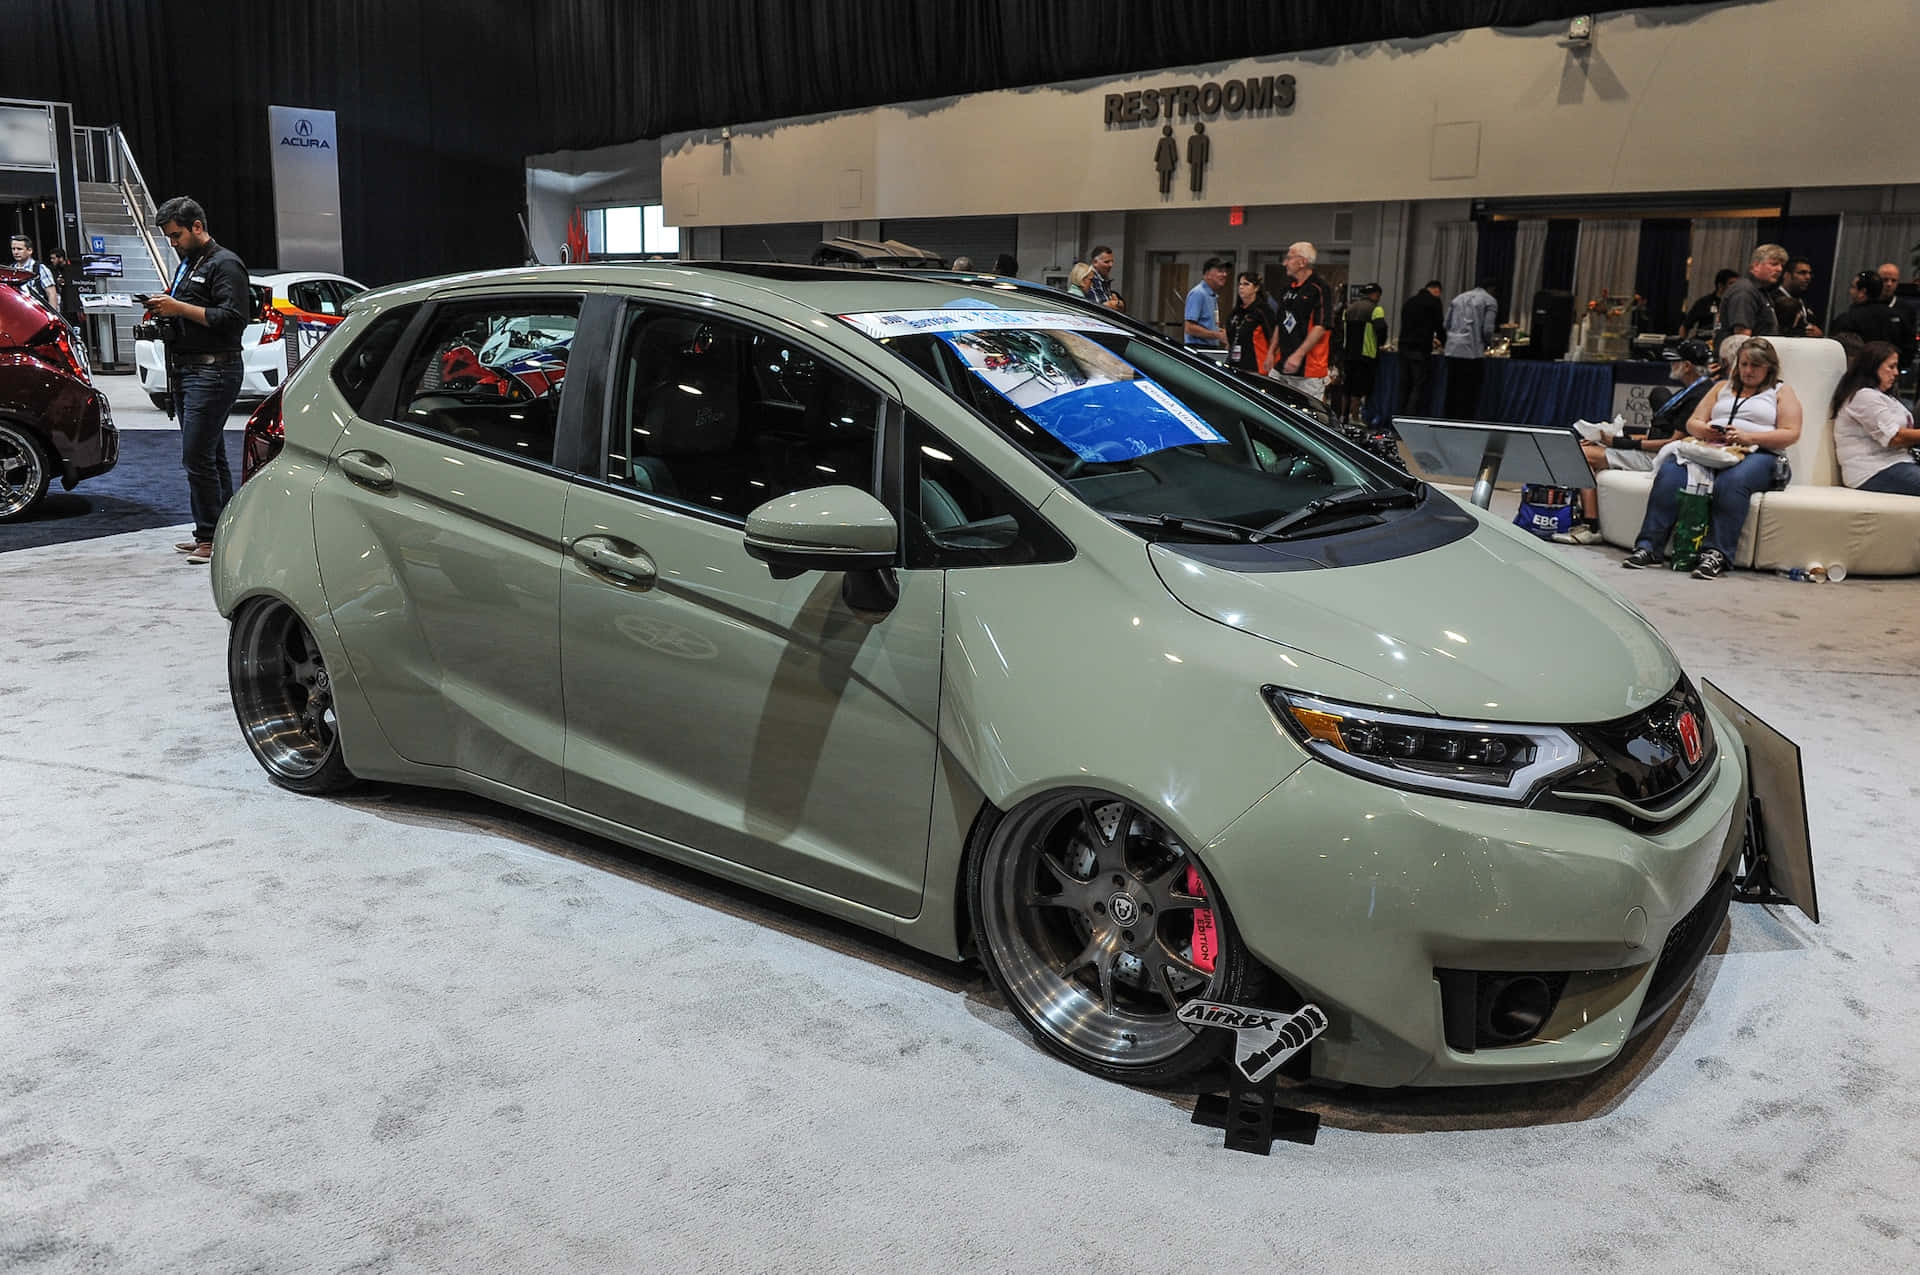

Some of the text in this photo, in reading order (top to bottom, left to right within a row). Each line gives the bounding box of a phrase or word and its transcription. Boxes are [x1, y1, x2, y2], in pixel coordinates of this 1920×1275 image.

[1104, 74, 1296, 123] RESTROOMS
[280, 136, 330, 149] ACURA
[1532, 514, 1559, 527] EBC
[1197, 918, 1210, 961] EDITION
